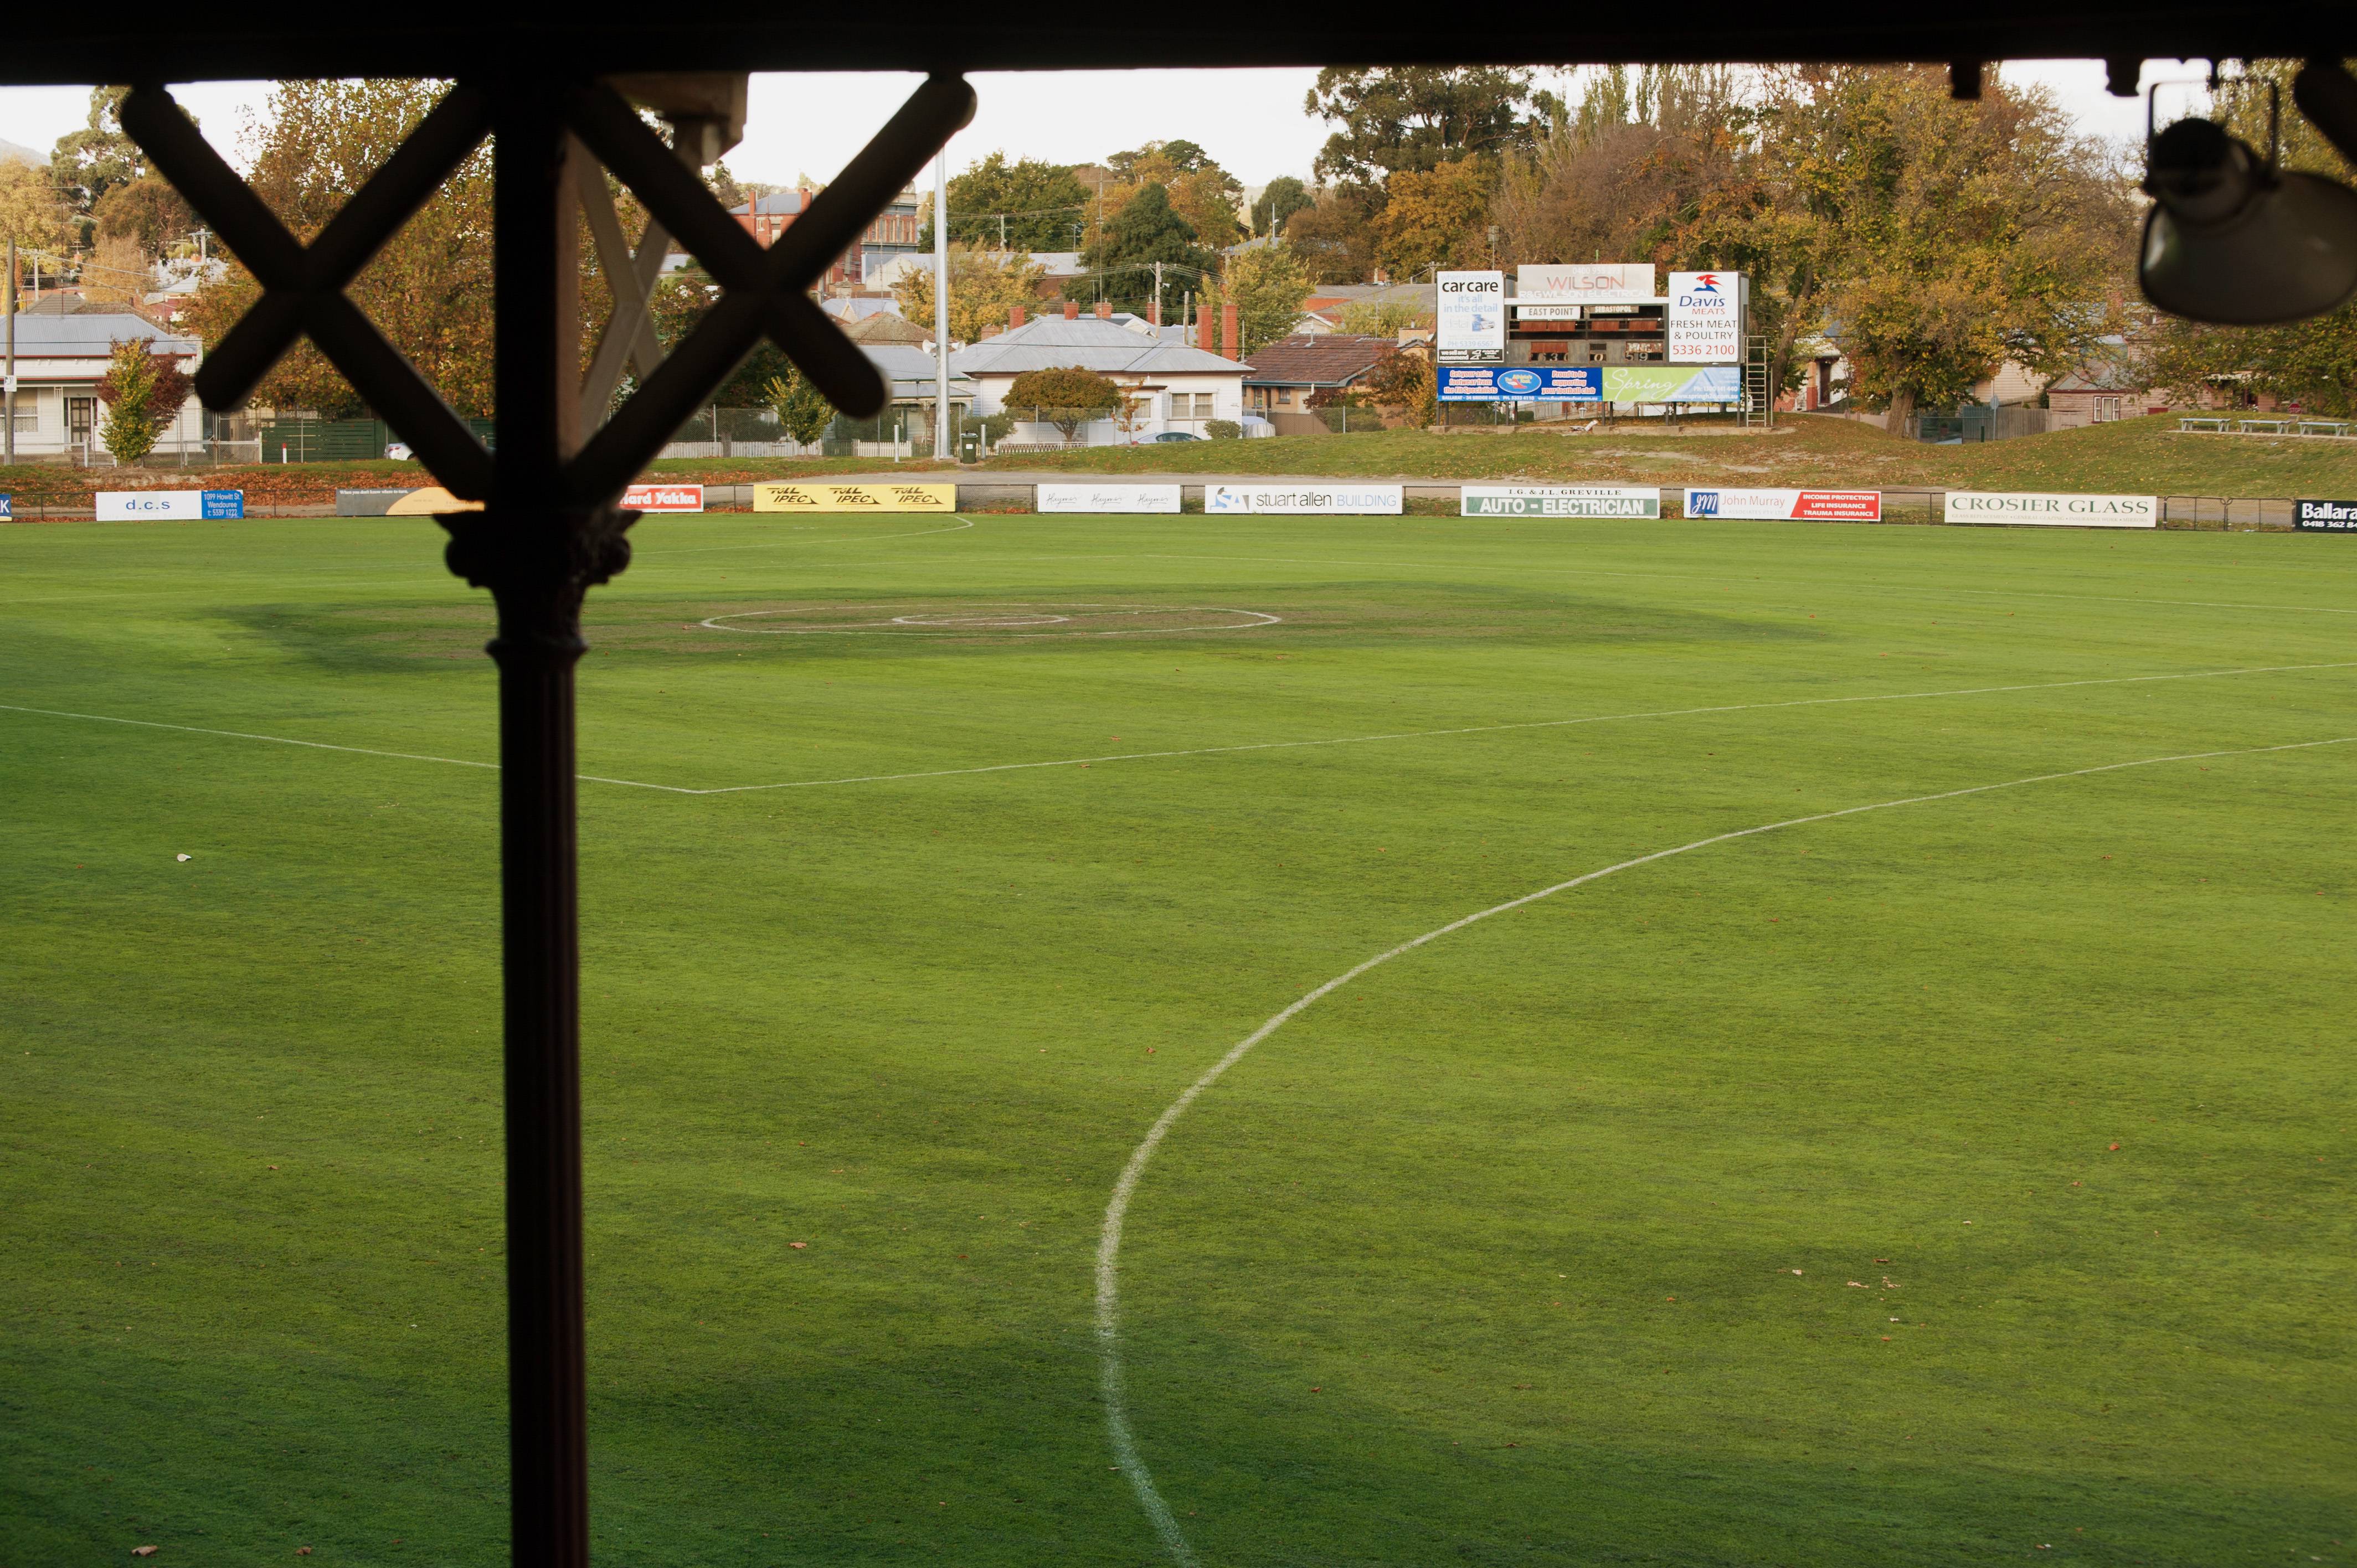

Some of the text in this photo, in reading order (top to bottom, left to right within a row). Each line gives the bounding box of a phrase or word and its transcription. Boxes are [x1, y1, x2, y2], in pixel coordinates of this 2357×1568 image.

[1442, 282, 1499, 292] car care
[1547, 272, 1625, 290] WILSON
[1458, 294, 1483, 303] it's all
[1679, 296, 1726, 307] Davis
[1444, 303, 1498, 313] in the detail
[1673, 345, 1701, 355] 5336
[1706, 345, 1735, 355] 2100
[1604, 368, 1677, 400] Spring
[655, 492, 697, 504] Yakka
[1256, 492, 1396, 507] stuart allen BUILDING
[1722, 495, 1785, 508] John Murray
[126, 499, 171, 510] d.c.s
[1479, 497, 1525, 514] AUTO
[1542, 499, 1644, 515] ELECTRICIAN
[1952, 497, 2149, 514] CROSIER GLASS
